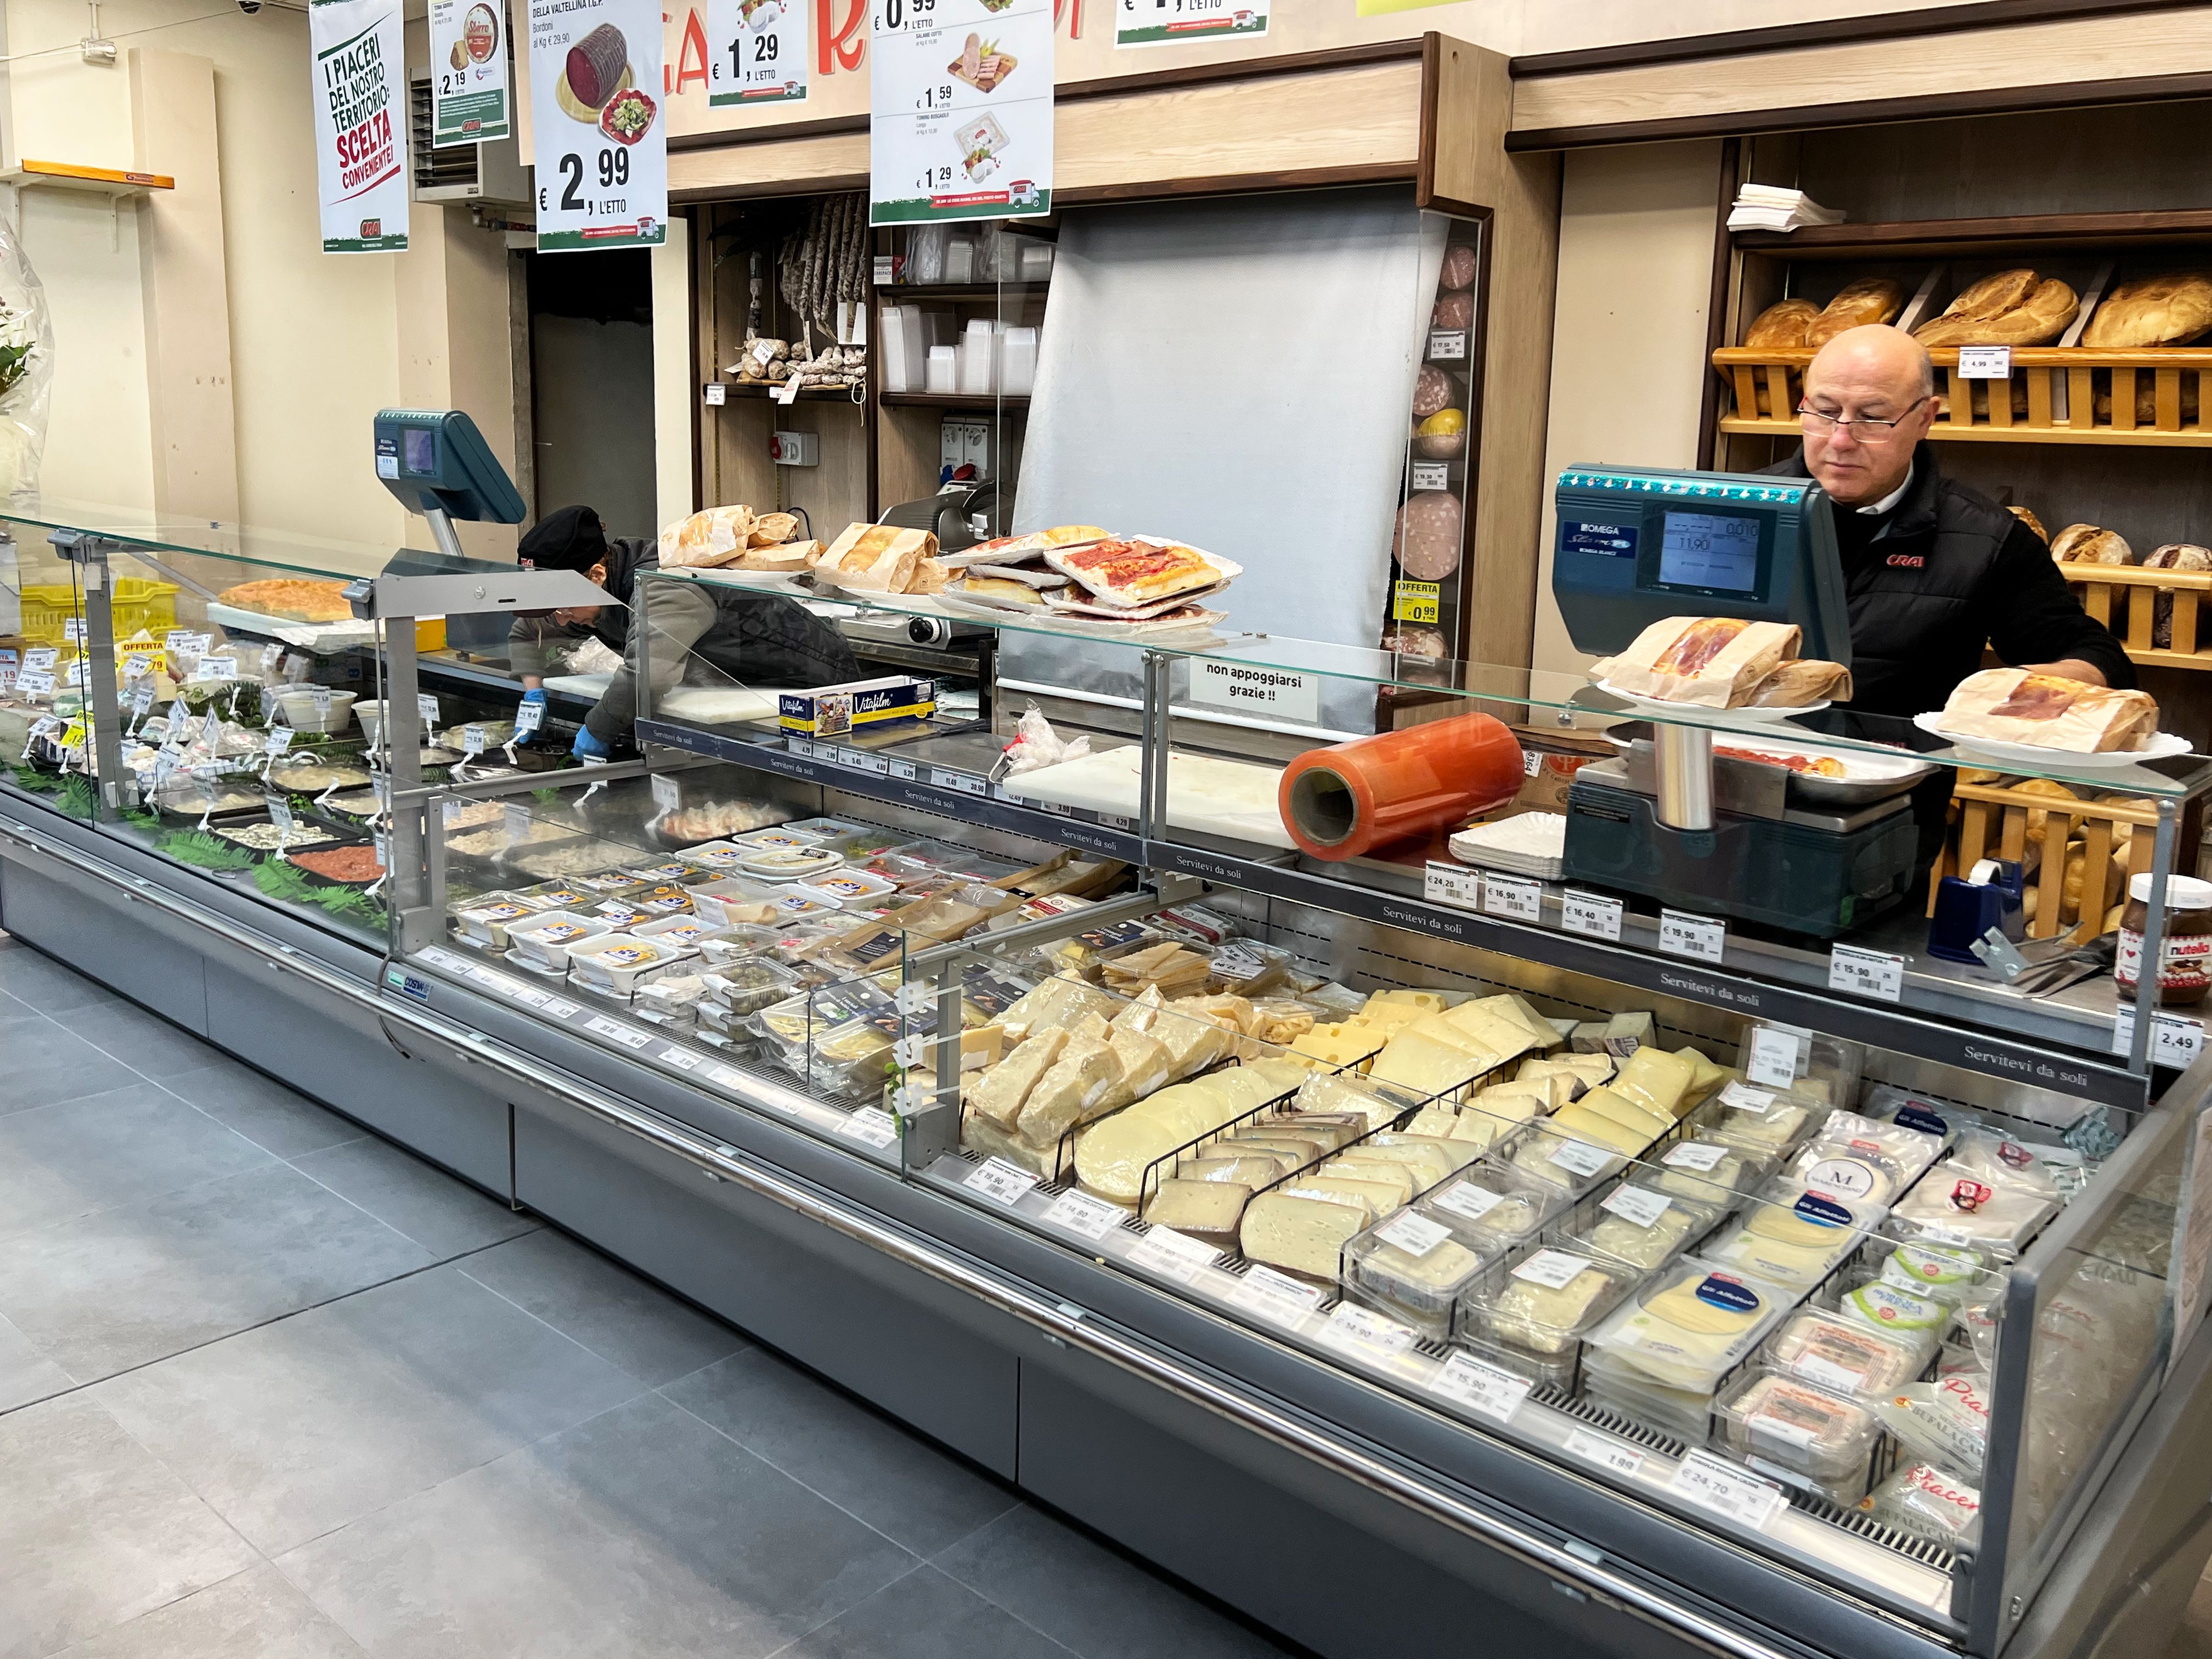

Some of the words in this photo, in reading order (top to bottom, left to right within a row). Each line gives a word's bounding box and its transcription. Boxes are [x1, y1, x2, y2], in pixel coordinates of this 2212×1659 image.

[533, 5, 550, 18] DELLA
[551, 0, 586, 14] VALTELLINA
[533, 20, 553, 33] Bordoni
[874, 15, 879, 30] €
[912, 19, 933, 29] L'ETTO
[533, 39, 538, 48] al
[539, 37, 546, 49] Kg
[549, 35, 552, 46] €
[554, 33, 570, 45] 29,90
[755, 34, 778, 62] 29
[333, 32, 381, 84] PIACERI
[455, 72, 465, 86] 19
[713, 63, 719, 80] €
[755, 69, 775, 81] L'ETTO
[329, 85, 350, 111] DEL
[352, 61, 385, 101] NOSTRO
[916, 100, 921, 108] €
[940, 86, 951, 99] 59
[332, 84, 391, 133] TERRITORIO:
[337, 109, 392, 168] SCELTA
[599, 146, 629, 187] 99
[916, 180, 921, 188] €
[940, 167, 952, 180] 29
[539, 188, 548, 211] €
[600, 199, 627, 215] L'ETTO
[362, 221, 380, 236] CRAI
[1588, 524, 1620, 535] OMEGA
[1887, 554, 1925, 567] CRAI
[1398, 583, 1437, 592] OFFERTA
[1424, 606, 1435, 616] 99
[123, 642, 163, 651] OFFERTA
[4, 670, 16, 679] 19
[1207, 664, 1228, 675] non
[1231, 668, 1302, 688] appoggiarsi
[1229, 685, 1265, 699] grazie
[1268, 690, 1276, 701] !!
[781, 697, 804, 714] Vitafilm
[855, 692, 891, 713] Vitafilm
[771, 758, 794, 771] Servitevi
[1525, 752, 1535, 772] 8364
[905, 789, 932, 805] Servitevi
[934, 797, 943, 807] da
[944, 799, 955, 809] soli
[1061, 828, 1092, 844] Servitevi
[1093, 837, 1102, 847] da
[1104, 841, 1117, 850] soli
[1176, 855, 1213, 873] Servitevi
[1215, 865, 1224, 876] da
[1227, 869, 1242, 879] soli
[1434, 878, 1454, 888] 24,20
[1496, 889, 1516, 900] 16,90
[1383, 906, 1426, 926] Servitevi
[1429, 916, 1441, 928] da
[1444, 922, 1462, 934] soli
[1574, 909, 1595, 919] 16,40
[2170, 942, 2210, 955] nutella
[1834, 962, 1841, 970] €
[1661, 973, 1715, 996] Servitevi
[1719, 985, 1734, 1001] da
[1737, 991, 1759, 1007] soli
[1964, 1046, 2032, 1073] Servitevi
[2036, 1062, 2055, 1079] da
[2059, 1069, 2087, 1086] soli
[984, 1171, 1003, 1184] 19,90
[1830, 1171, 1854, 1186] M
[1069, 1205, 1088, 1218] 14,80
[1812, 1206, 1851, 1222] Affettati
[1716, 1290, 1757, 1306] Affettati
[1681, 1468, 1690, 1477] €
[1691, 1472, 1729, 1494] 24,70
